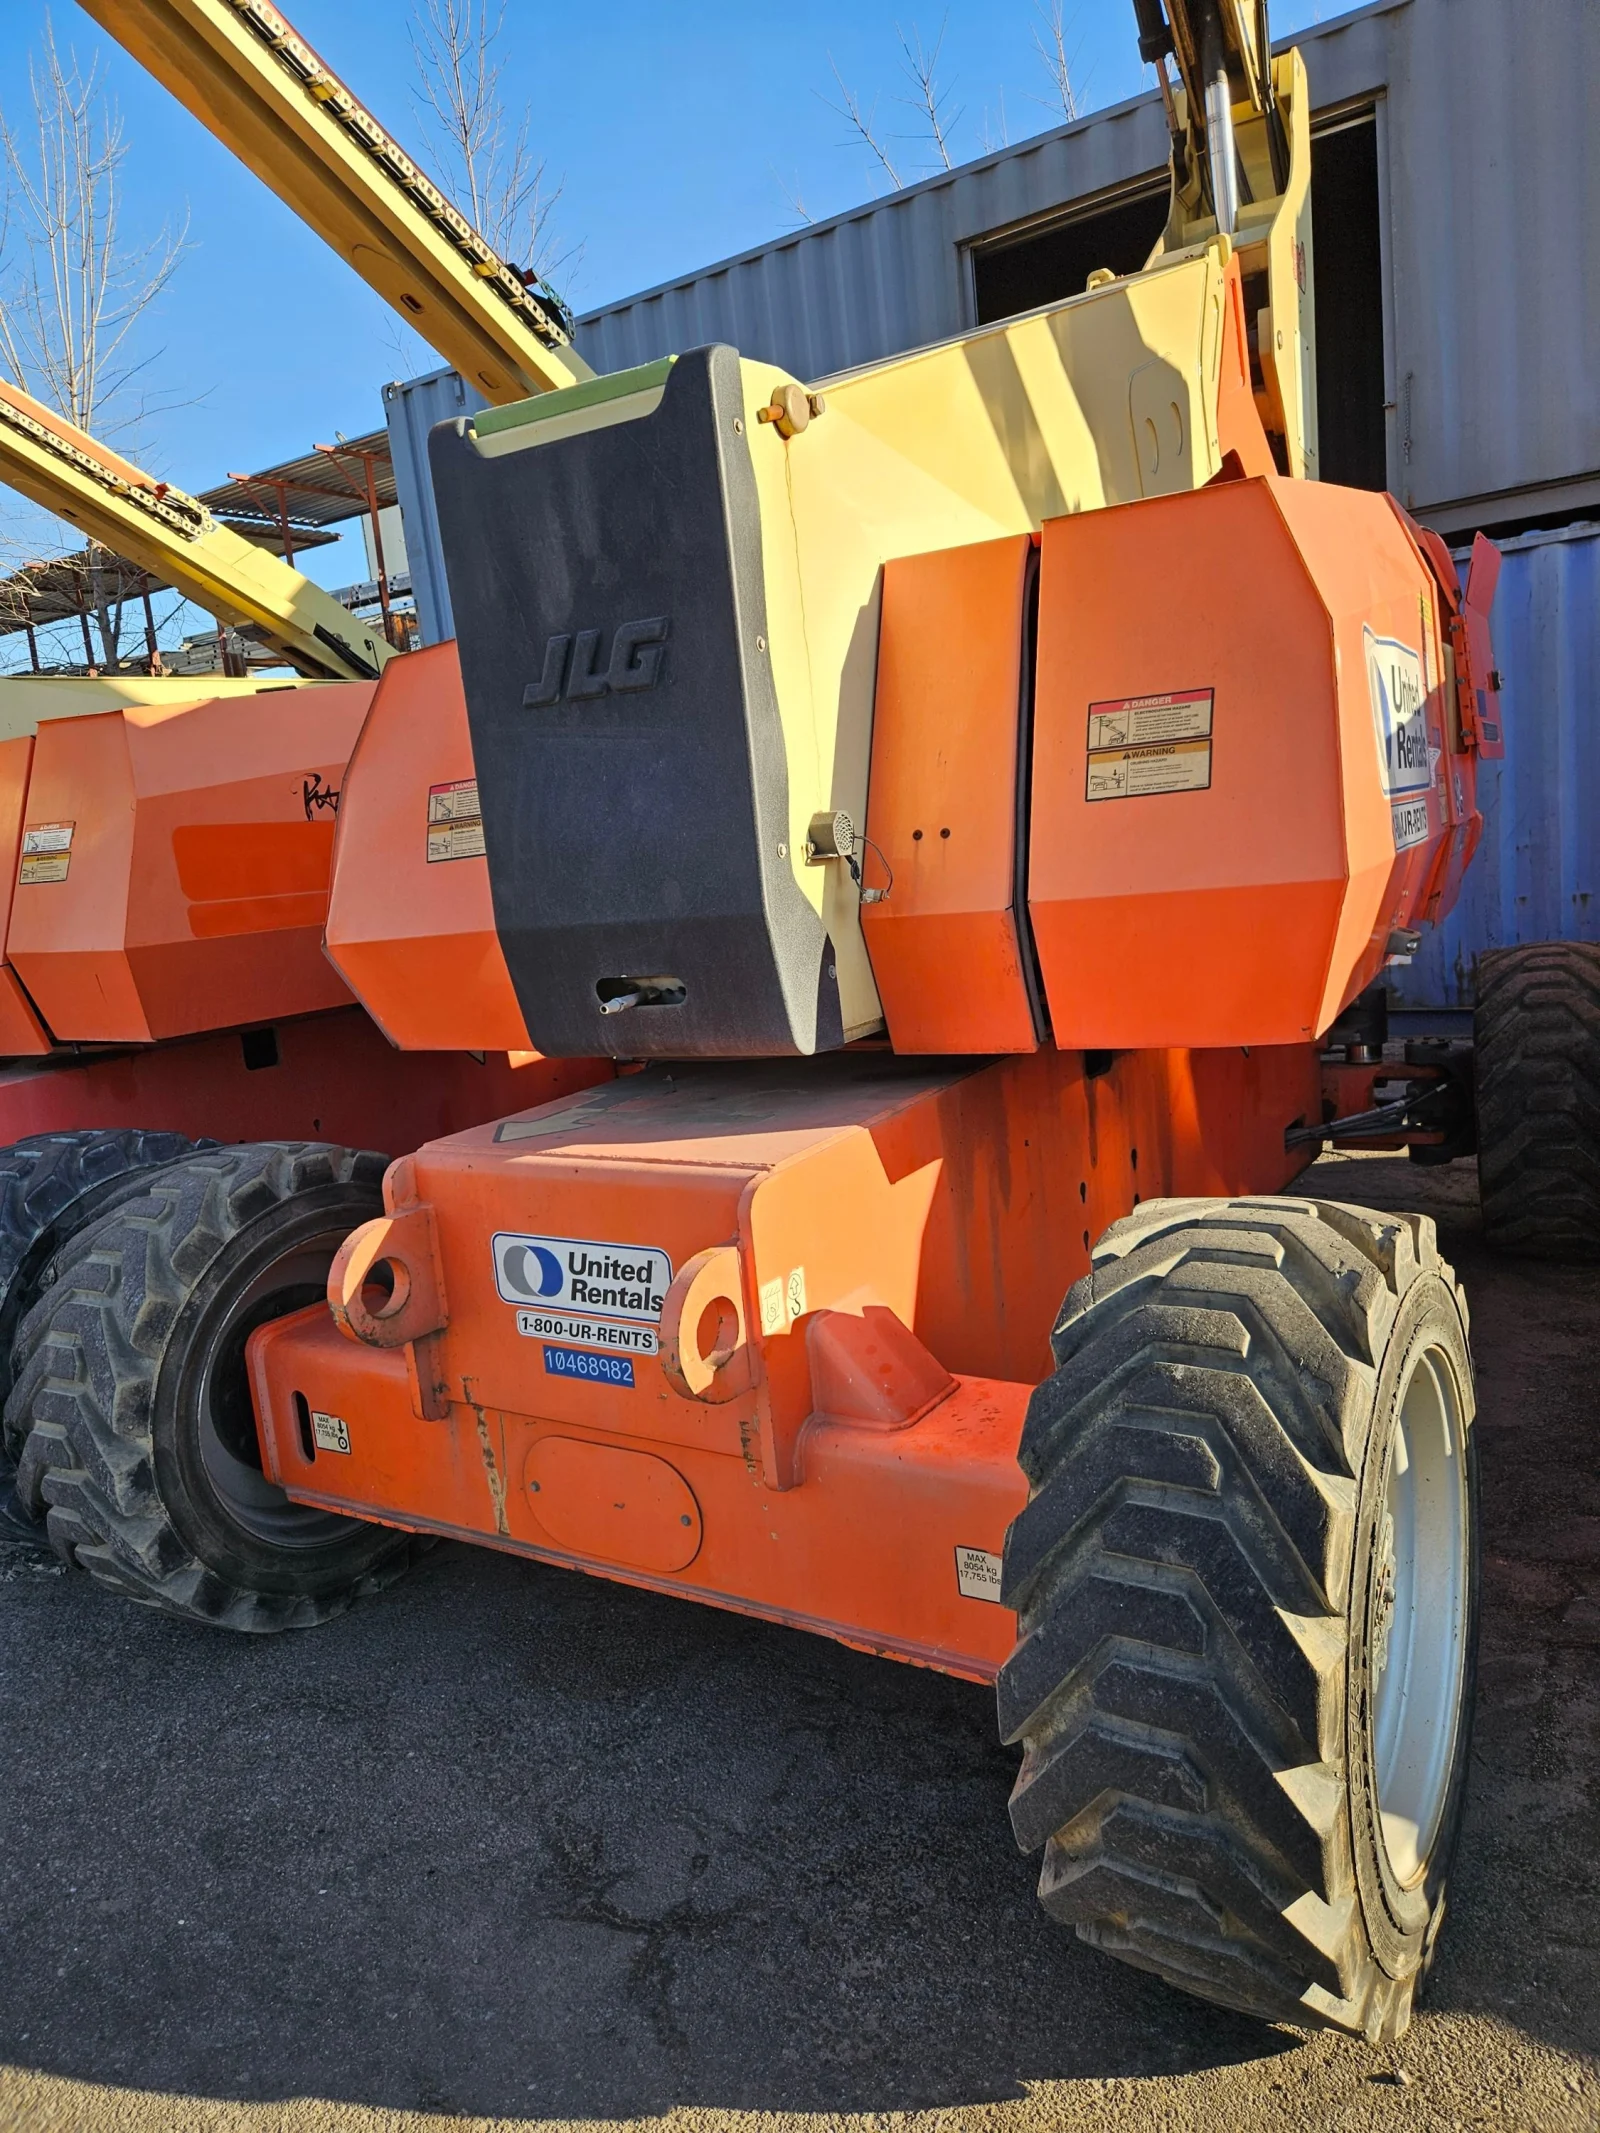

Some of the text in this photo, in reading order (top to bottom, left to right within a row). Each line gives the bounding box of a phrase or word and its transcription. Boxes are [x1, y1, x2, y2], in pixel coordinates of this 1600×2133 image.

[522, 615, 669, 708] JLG
[1131, 696, 1172, 709] DANGER
[1391, 665, 1421, 717] United
[1131, 747, 1175, 759] WARNING
[1397, 722, 1427, 769] Rentals
[454, 780, 477, 790] DANGE
[568, 1251, 653, 1284] United
[571, 1278, 664, 1313] Rentals
[521, 1316, 653, 1348] 1-800-UR-RENTS
[545, 1350, 633, 1382] 10468982
[963, 1561, 997, 1577] 8054 kg
[967, 1552, 987, 1564] MAX
[989, 1575, 1002, 1586] lbs
